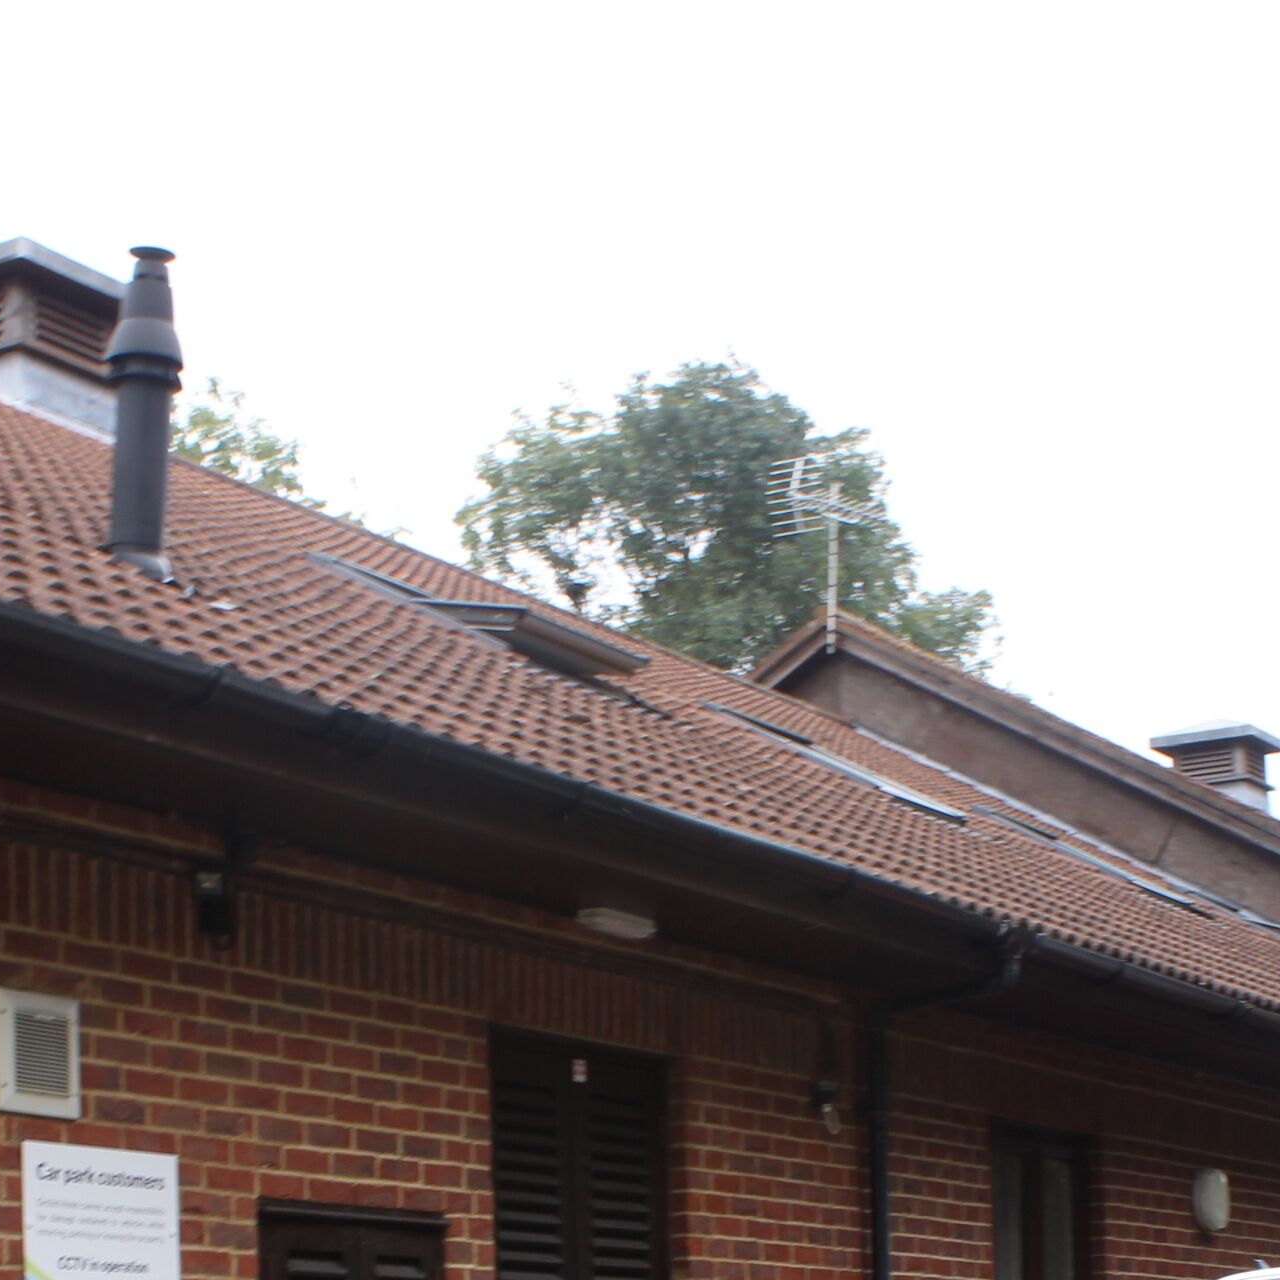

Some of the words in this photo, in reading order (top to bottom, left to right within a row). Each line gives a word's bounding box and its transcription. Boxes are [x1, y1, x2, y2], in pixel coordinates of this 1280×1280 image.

[35, 1161, 62, 1181] Car
[64, 1166, 95, 1186] park
[96, 1171, 166, 1190] customers
[57, 1254, 88, 1271] CCTV
[100, 1260, 149, 1275] operation
